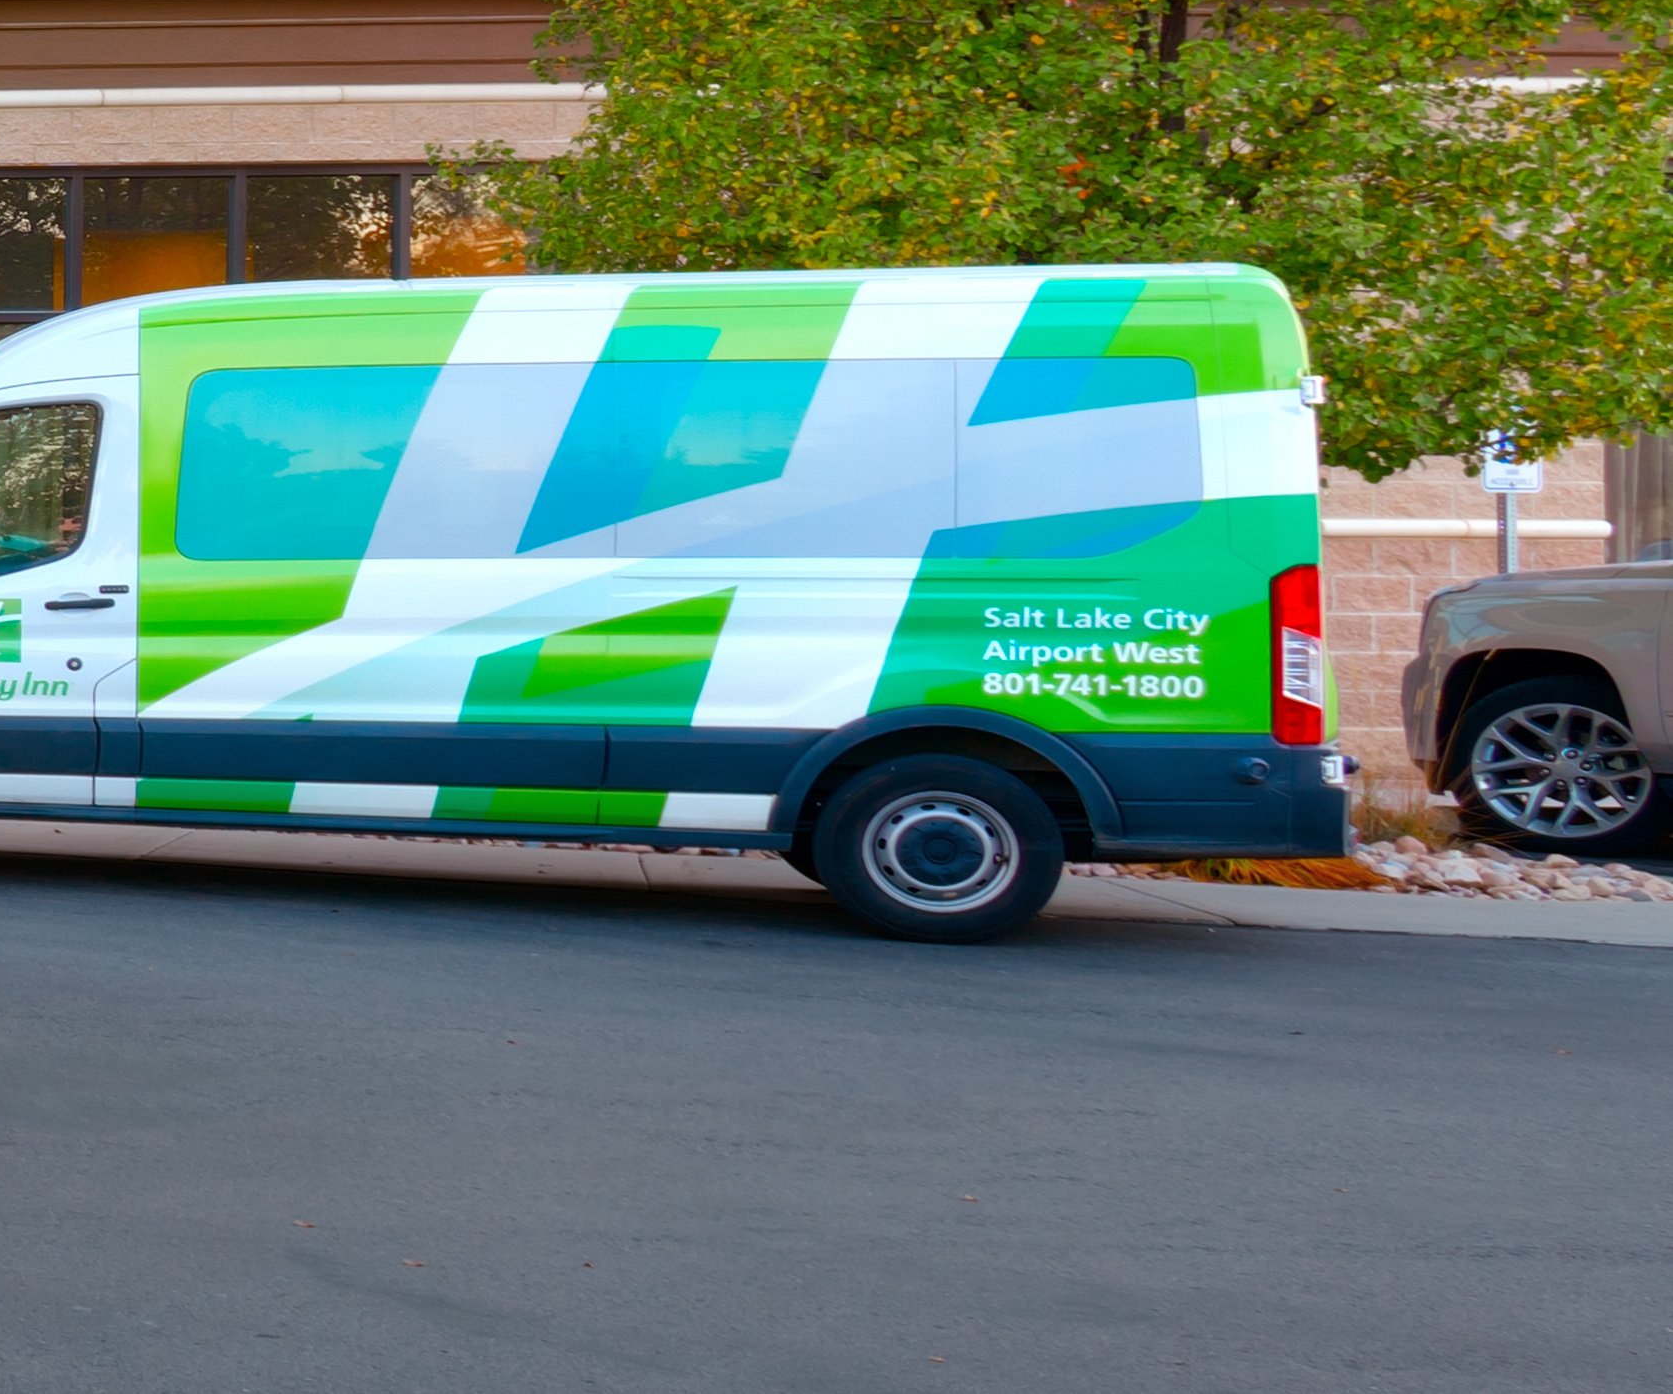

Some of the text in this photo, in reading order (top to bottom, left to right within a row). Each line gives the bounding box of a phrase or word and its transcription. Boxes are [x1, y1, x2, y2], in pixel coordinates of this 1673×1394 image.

[983, 607, 1209, 636] Salt Lake City
[982, 640, 1201, 666] Airport West
[21, 671, 70, 697] Inn
[983, 672, 1204, 699] 801-741-1800
